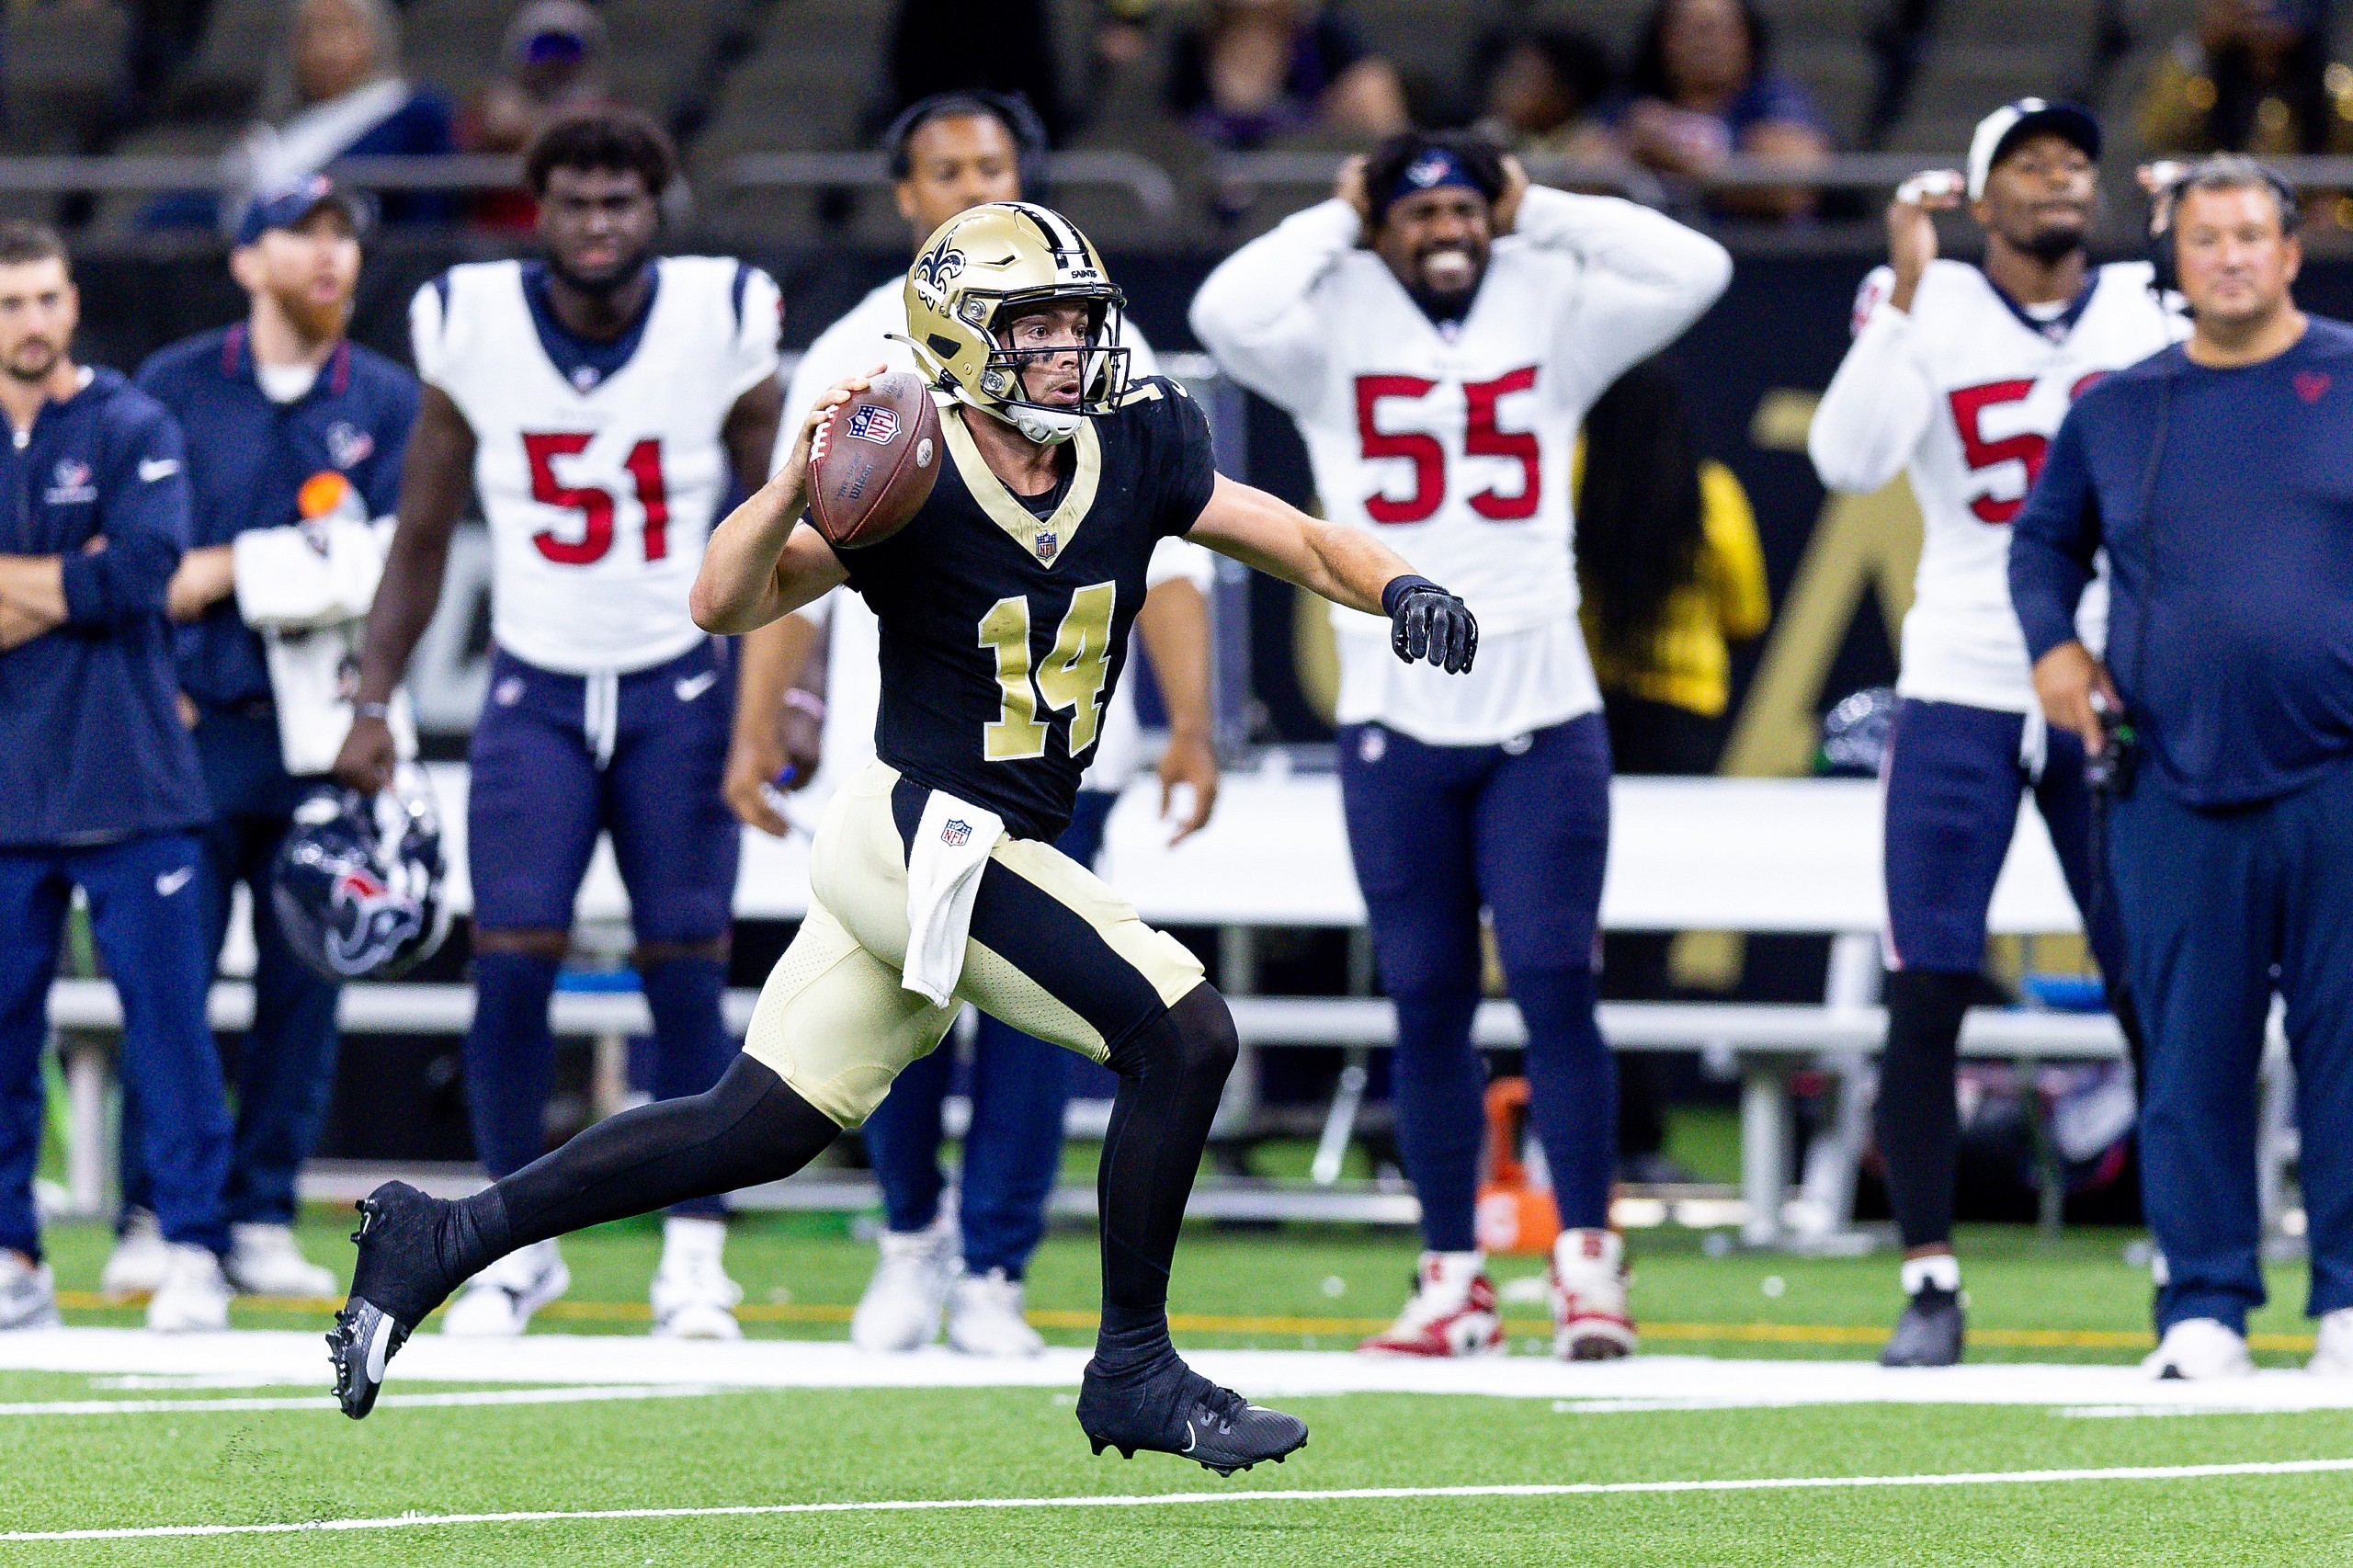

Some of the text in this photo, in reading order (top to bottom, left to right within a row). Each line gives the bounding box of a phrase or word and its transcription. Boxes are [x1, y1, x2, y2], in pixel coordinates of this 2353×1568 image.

[1071, 269, 1097, 278] SAINTS
[867, 413, 894, 440] NFL
[1354, 366, 1539, 525] 55
[520, 431, 667, 563] 51
[1040, 543, 1055, 555] NFL
[978, 580, 1115, 761] 14
[943, 829, 964, 844] NFL
